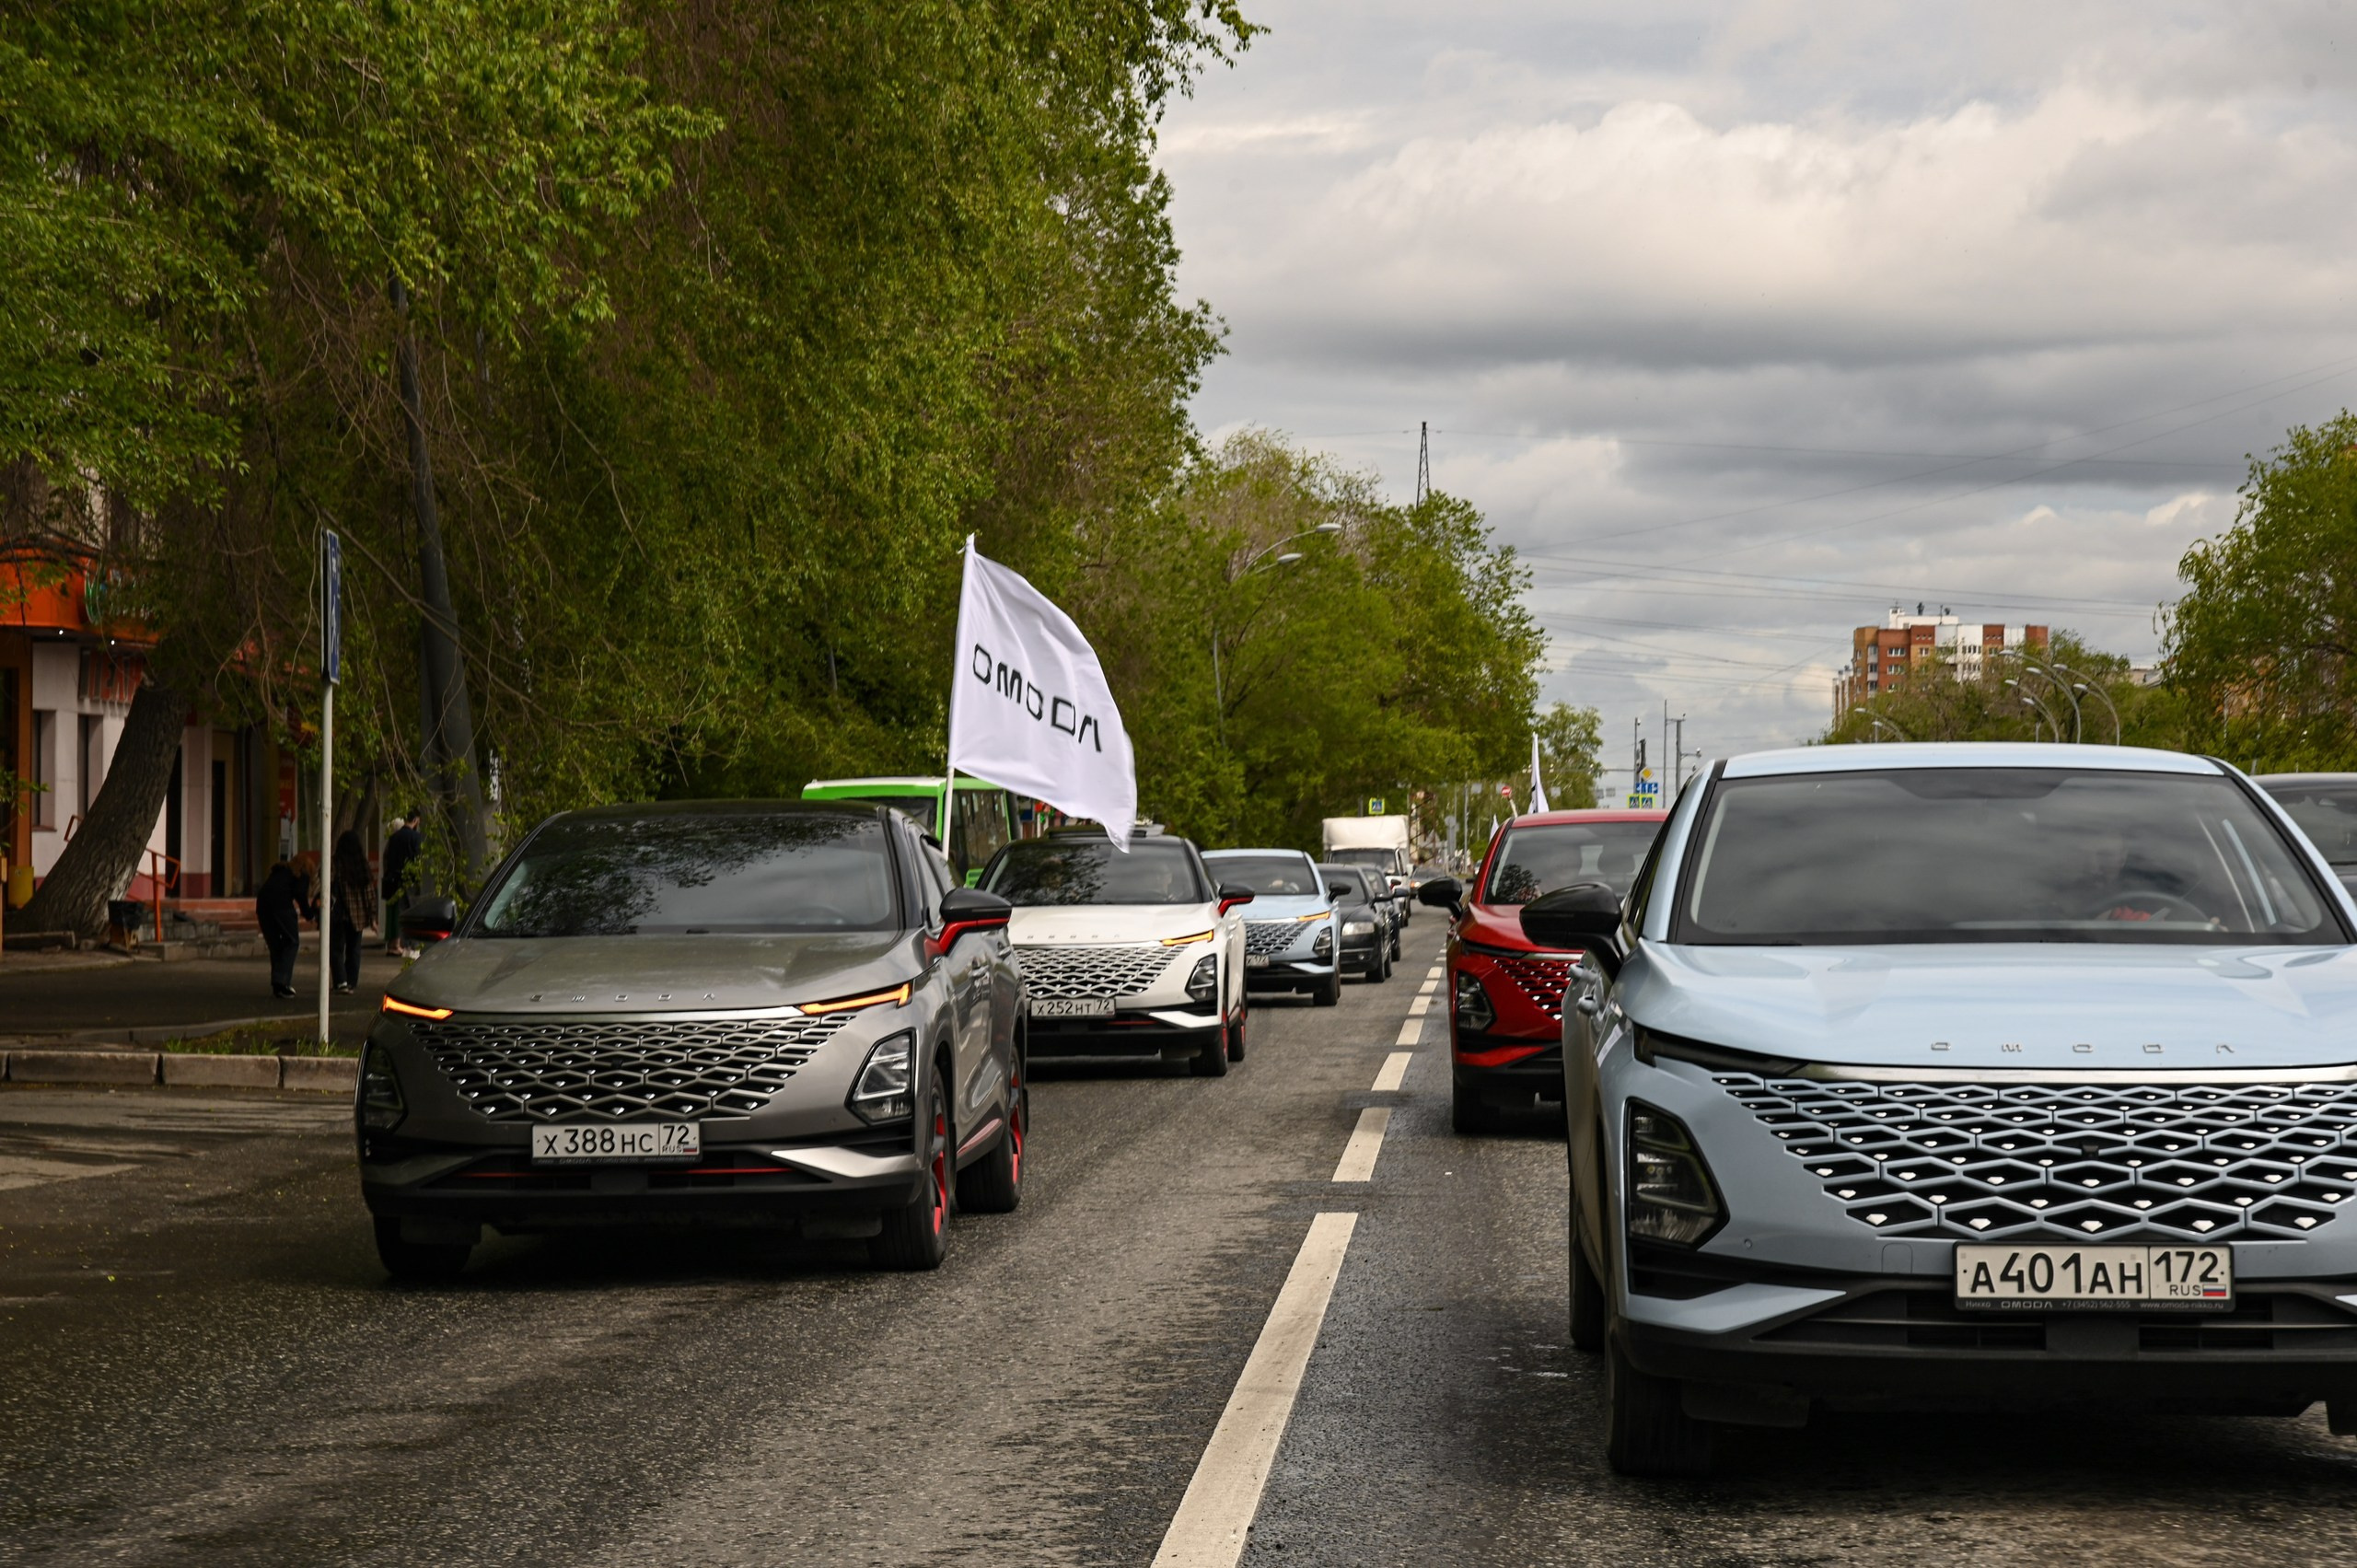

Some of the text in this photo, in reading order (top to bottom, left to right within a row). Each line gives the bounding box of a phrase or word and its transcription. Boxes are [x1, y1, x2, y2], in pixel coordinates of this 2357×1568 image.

[972, 643, 1102, 753] OMODA
[663, 1125, 691, 1145] 72
[662, 1145, 682, 1154] RUS
[2154, 1250, 2219, 1283] 172
[2169, 1283, 2201, 1296] RUS
